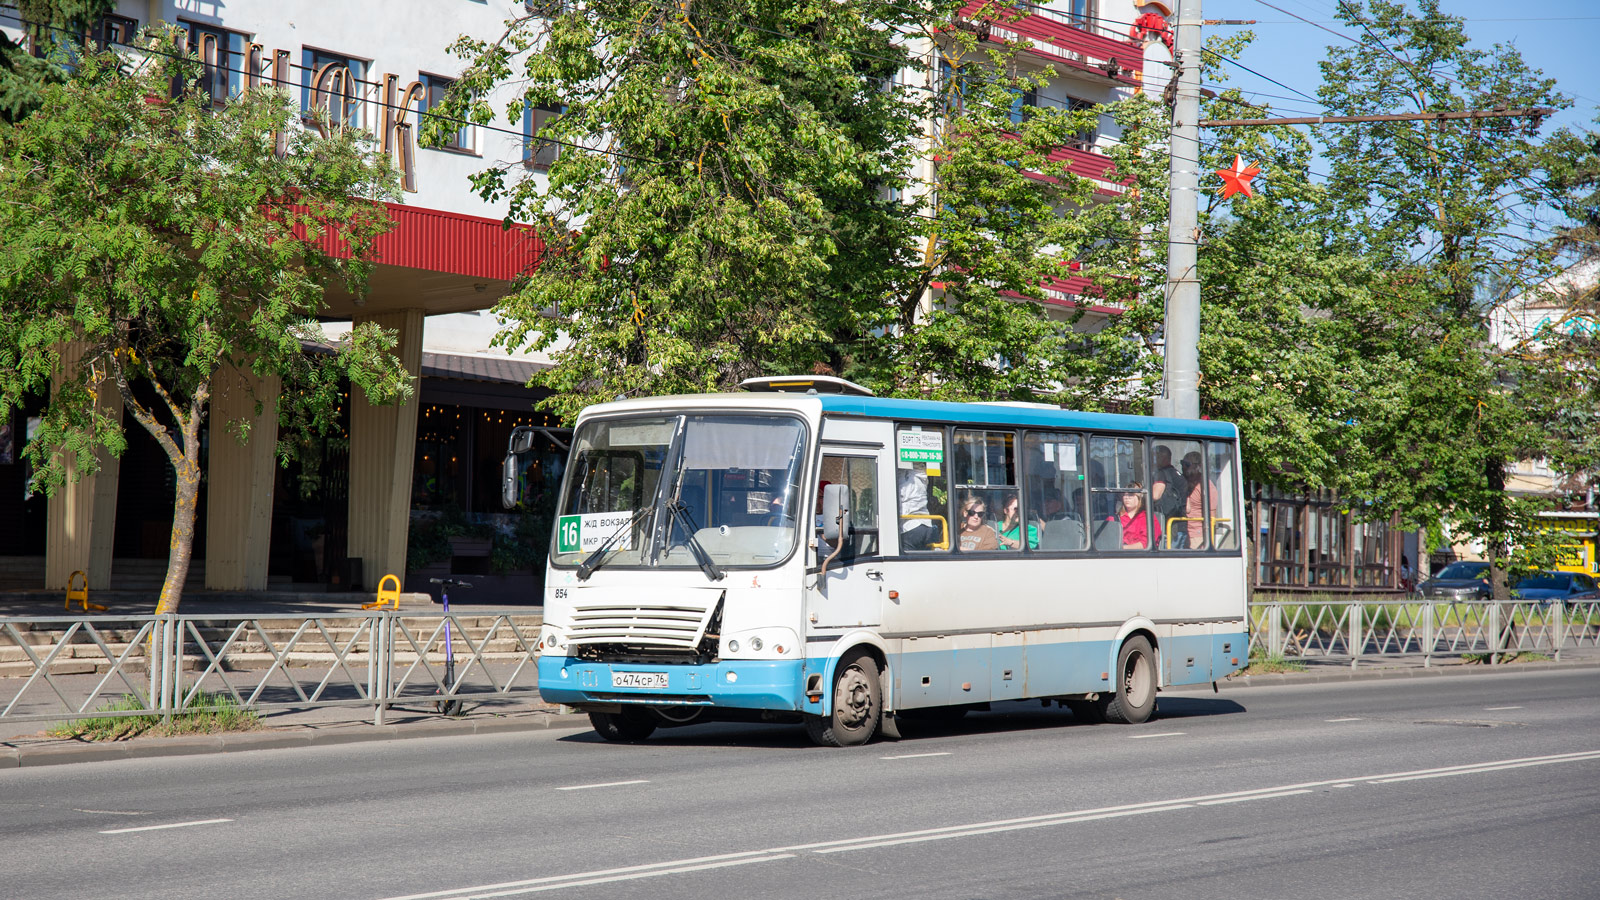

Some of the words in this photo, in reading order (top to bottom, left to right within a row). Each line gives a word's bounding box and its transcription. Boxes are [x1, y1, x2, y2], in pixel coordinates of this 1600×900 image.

[584, 519, 598, 528] Ж/Д
[562, 521, 578, 546] 16
[583, 537, 598, 545] МКР
[555, 588, 568, 599] 854
[655, 674, 665, 683] 76
